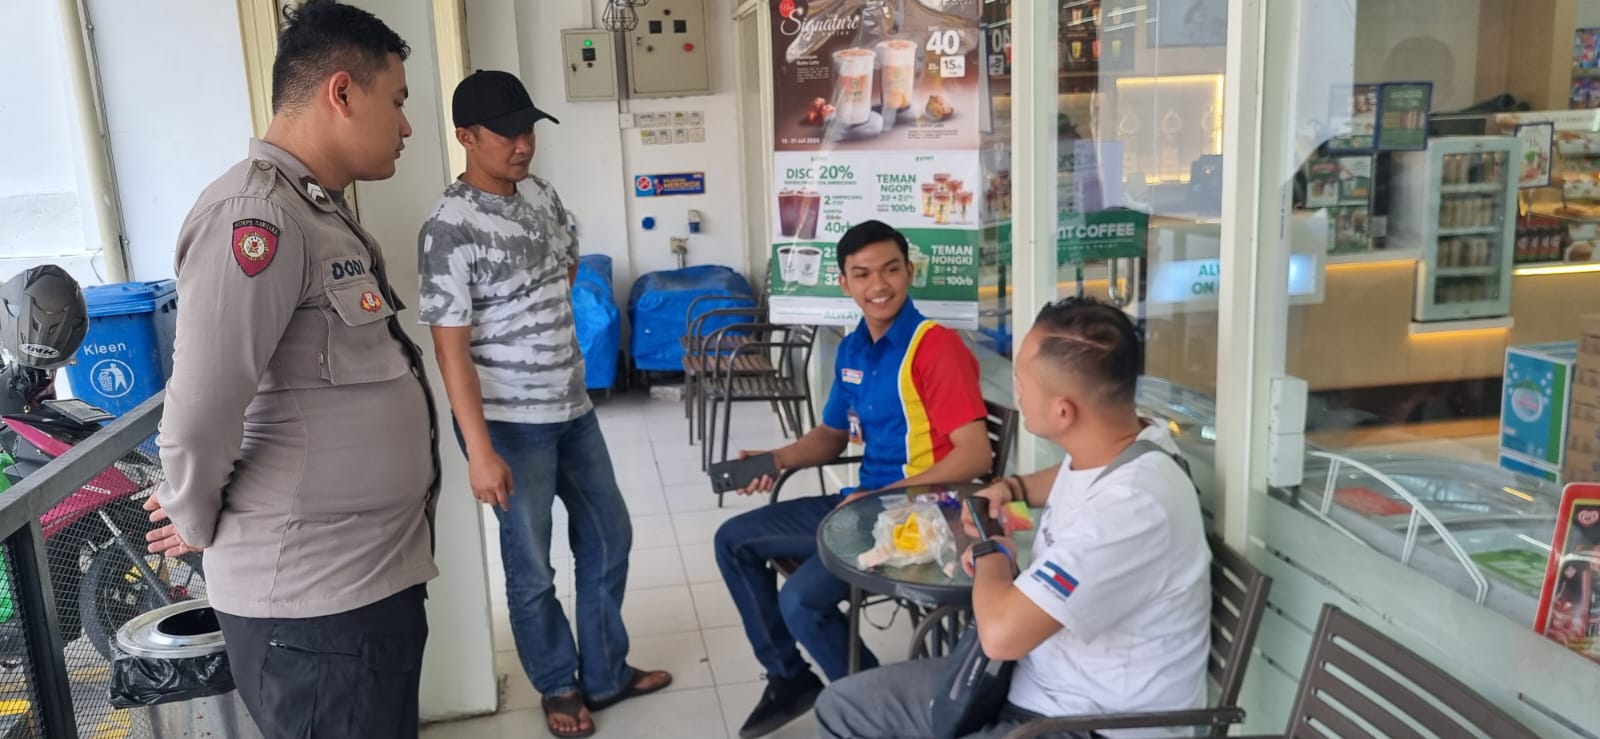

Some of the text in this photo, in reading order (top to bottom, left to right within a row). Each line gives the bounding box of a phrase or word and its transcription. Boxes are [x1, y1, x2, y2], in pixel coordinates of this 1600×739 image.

[786, 164, 854, 179] DISC 20%
[876, 174, 916, 183] TEMAN
[880, 184, 913, 193] NGOPI
[824, 195, 831, 206] 2
[891, 204, 916, 213] 100rb
[1076, 222, 1136, 238] COFFEE
[931, 245, 973, 256] TEMAN
[931, 256, 973, 265] NONGKI
[331, 258, 366, 280] DODI
[946, 276, 974, 286] 100rb
[84, 341, 127, 357] Kleen
